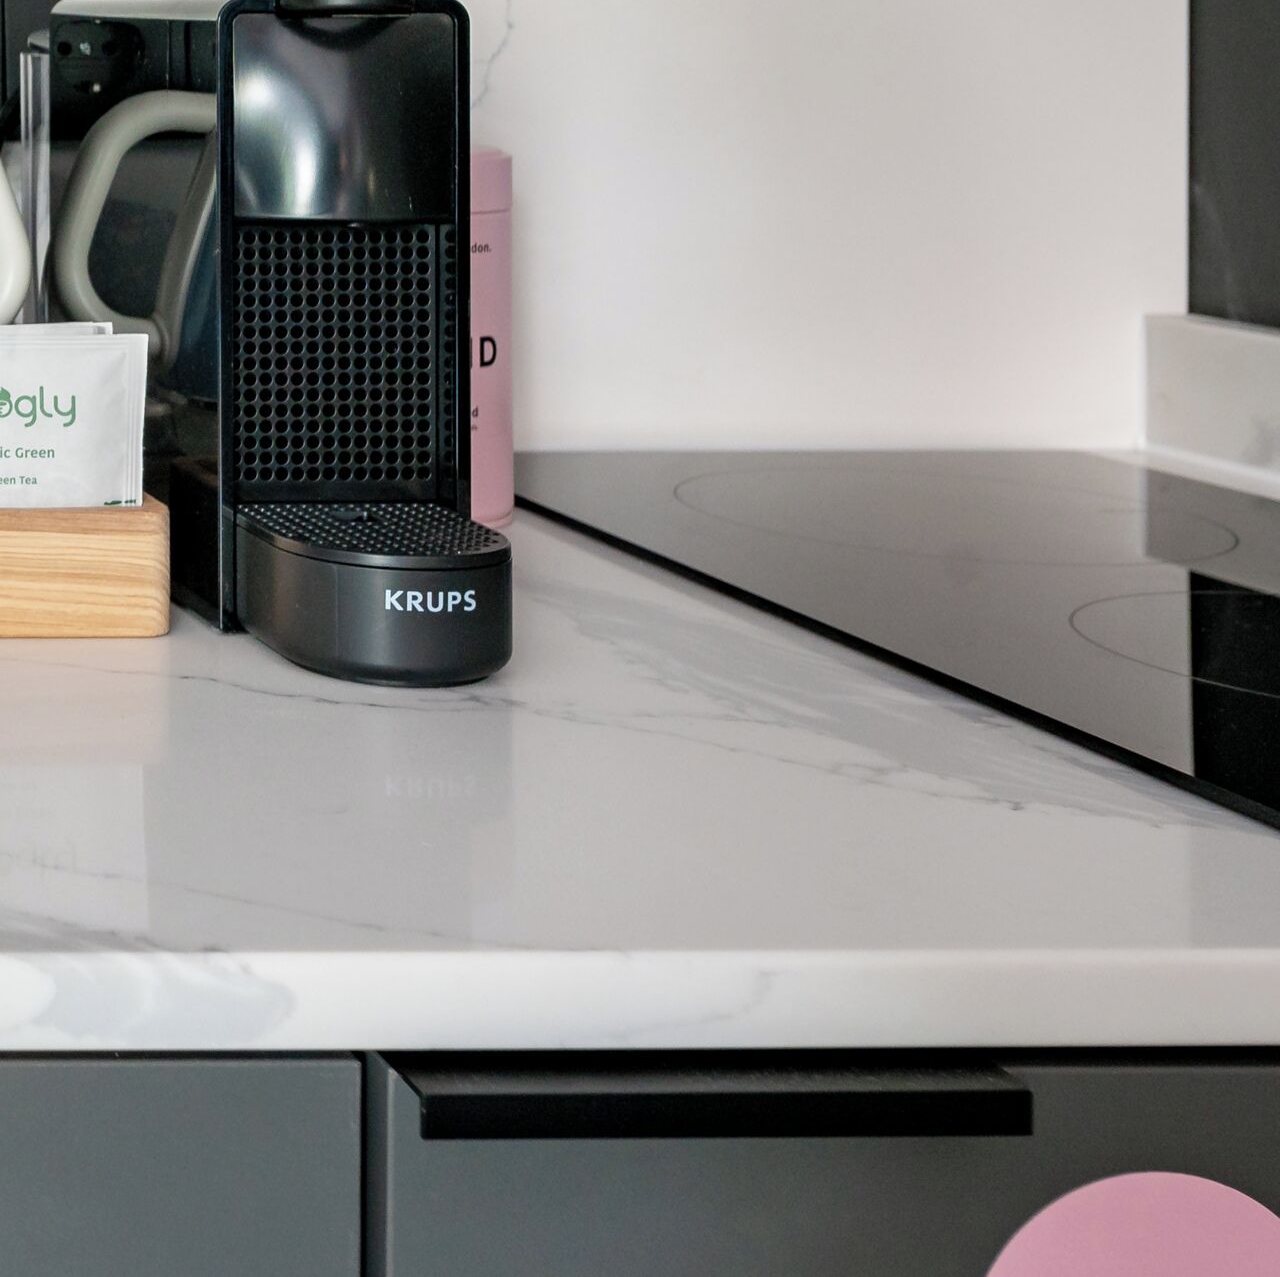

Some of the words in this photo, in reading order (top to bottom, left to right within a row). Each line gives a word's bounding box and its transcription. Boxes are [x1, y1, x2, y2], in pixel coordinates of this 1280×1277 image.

[471, 242, 492, 253] don.
[15, 447, 55, 459] Green
[19, 476, 38, 485] Tea
[384, 588, 477, 612] KRUPS
